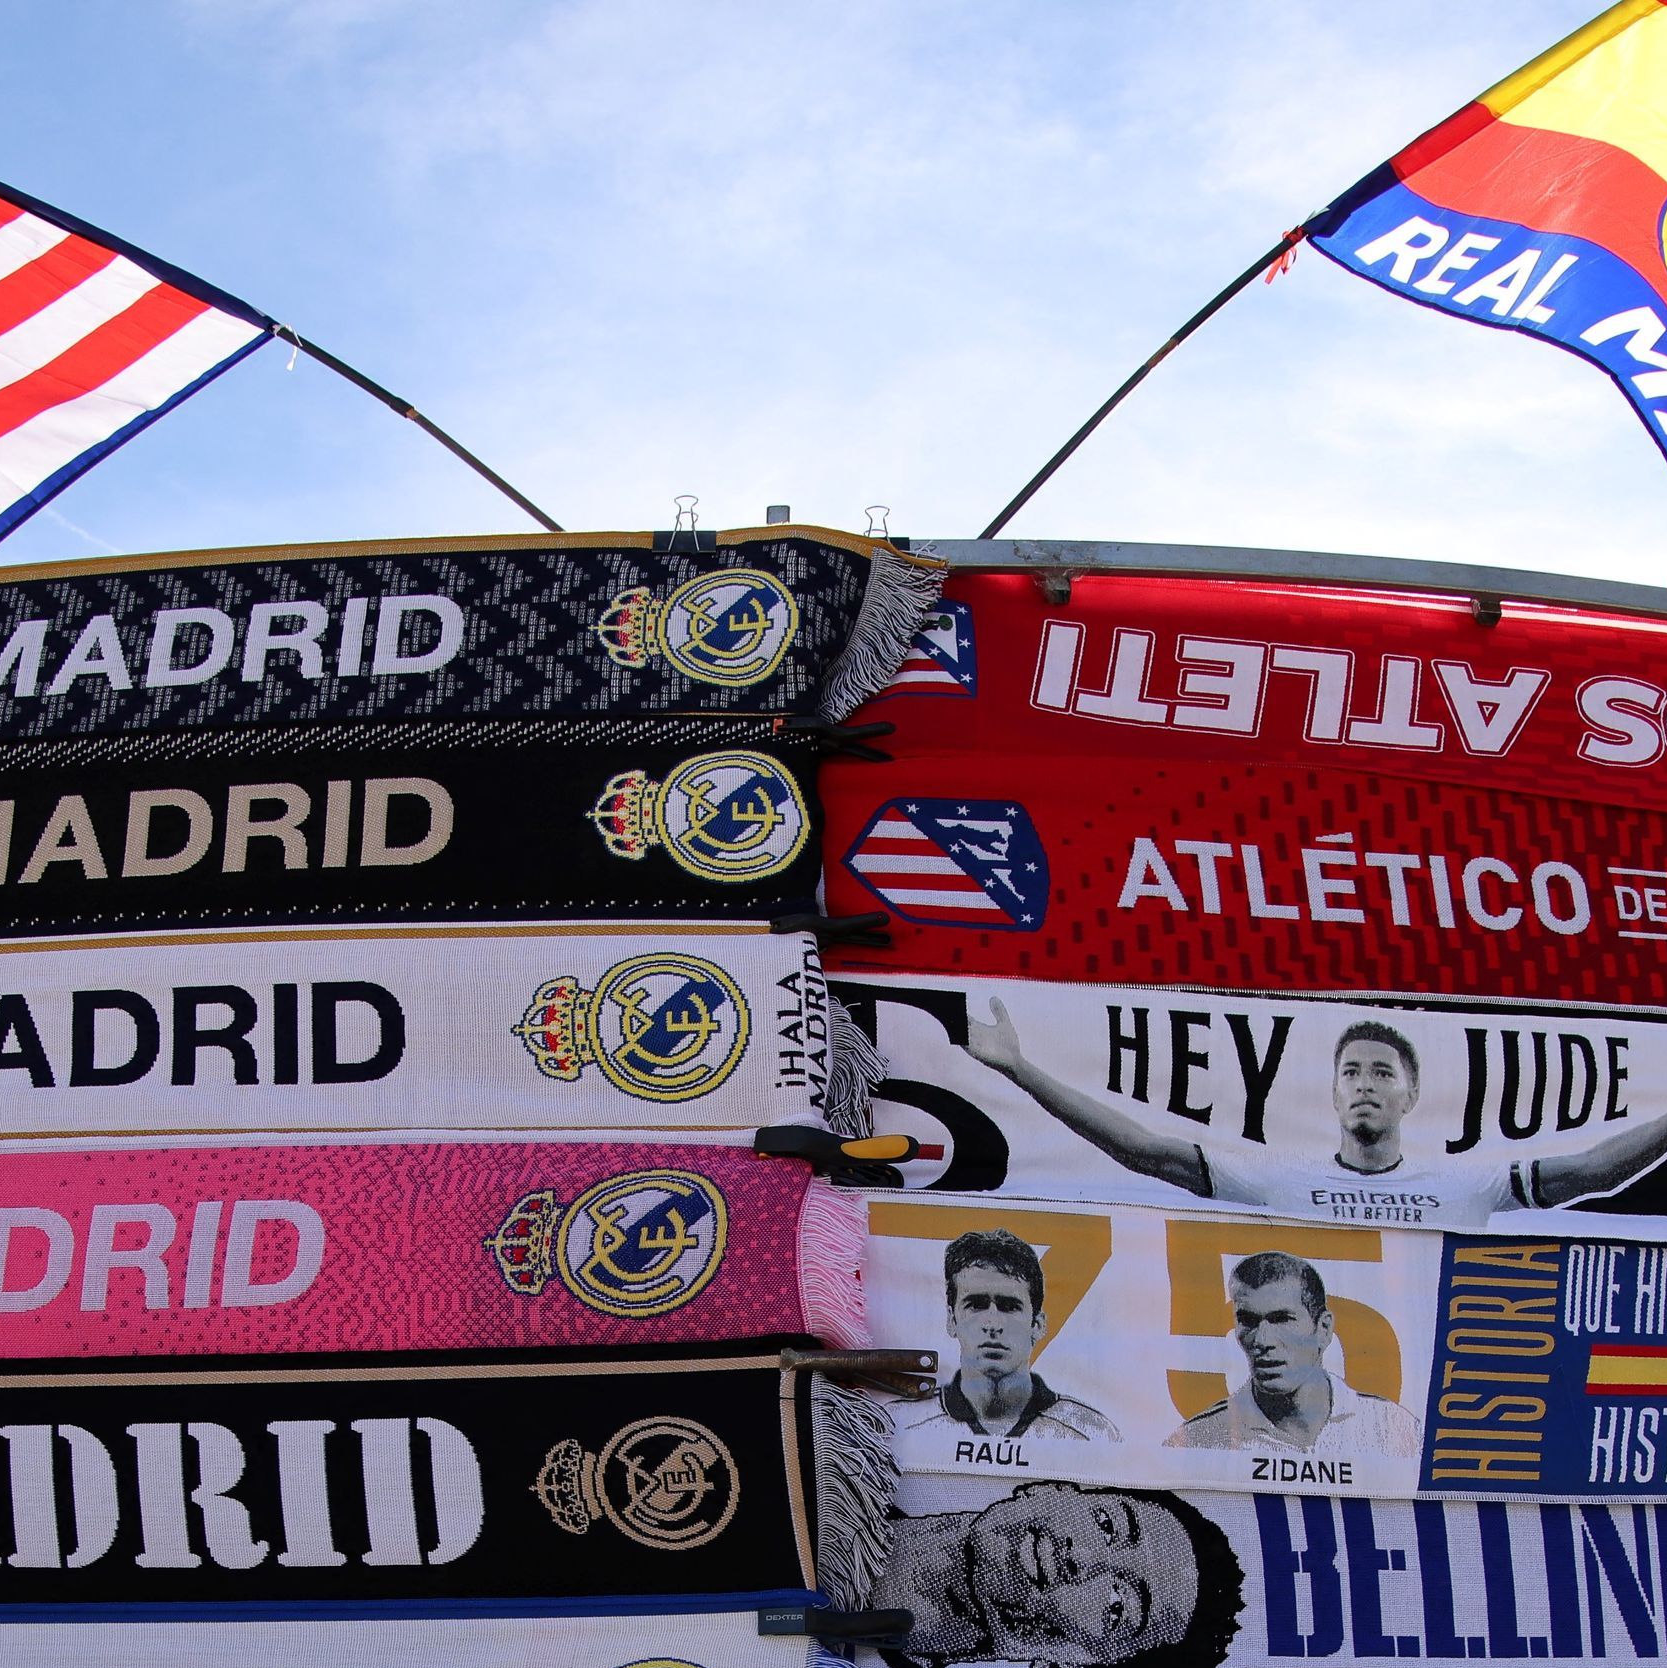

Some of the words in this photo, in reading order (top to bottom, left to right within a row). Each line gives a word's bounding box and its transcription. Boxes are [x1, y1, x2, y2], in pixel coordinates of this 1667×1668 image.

[1354, 215, 1581, 323] REAL
[1030, 618, 1552, 758] ATLETI
[1117, 831, 1592, 936] ATLÉTICO
[1106, 1004, 1295, 1143] HEY
[1445, 1028, 1629, 1155] JUDE
[1311, 1189, 1440, 1208] Emirates
[1564, 1244, 1623, 1337] QUE
[1432, 1243, 1562, 1482] HISTORIA
[954, 1438, 1030, 1467] RAÚL
[1251, 1457, 1354, 1485] ZIDANE
